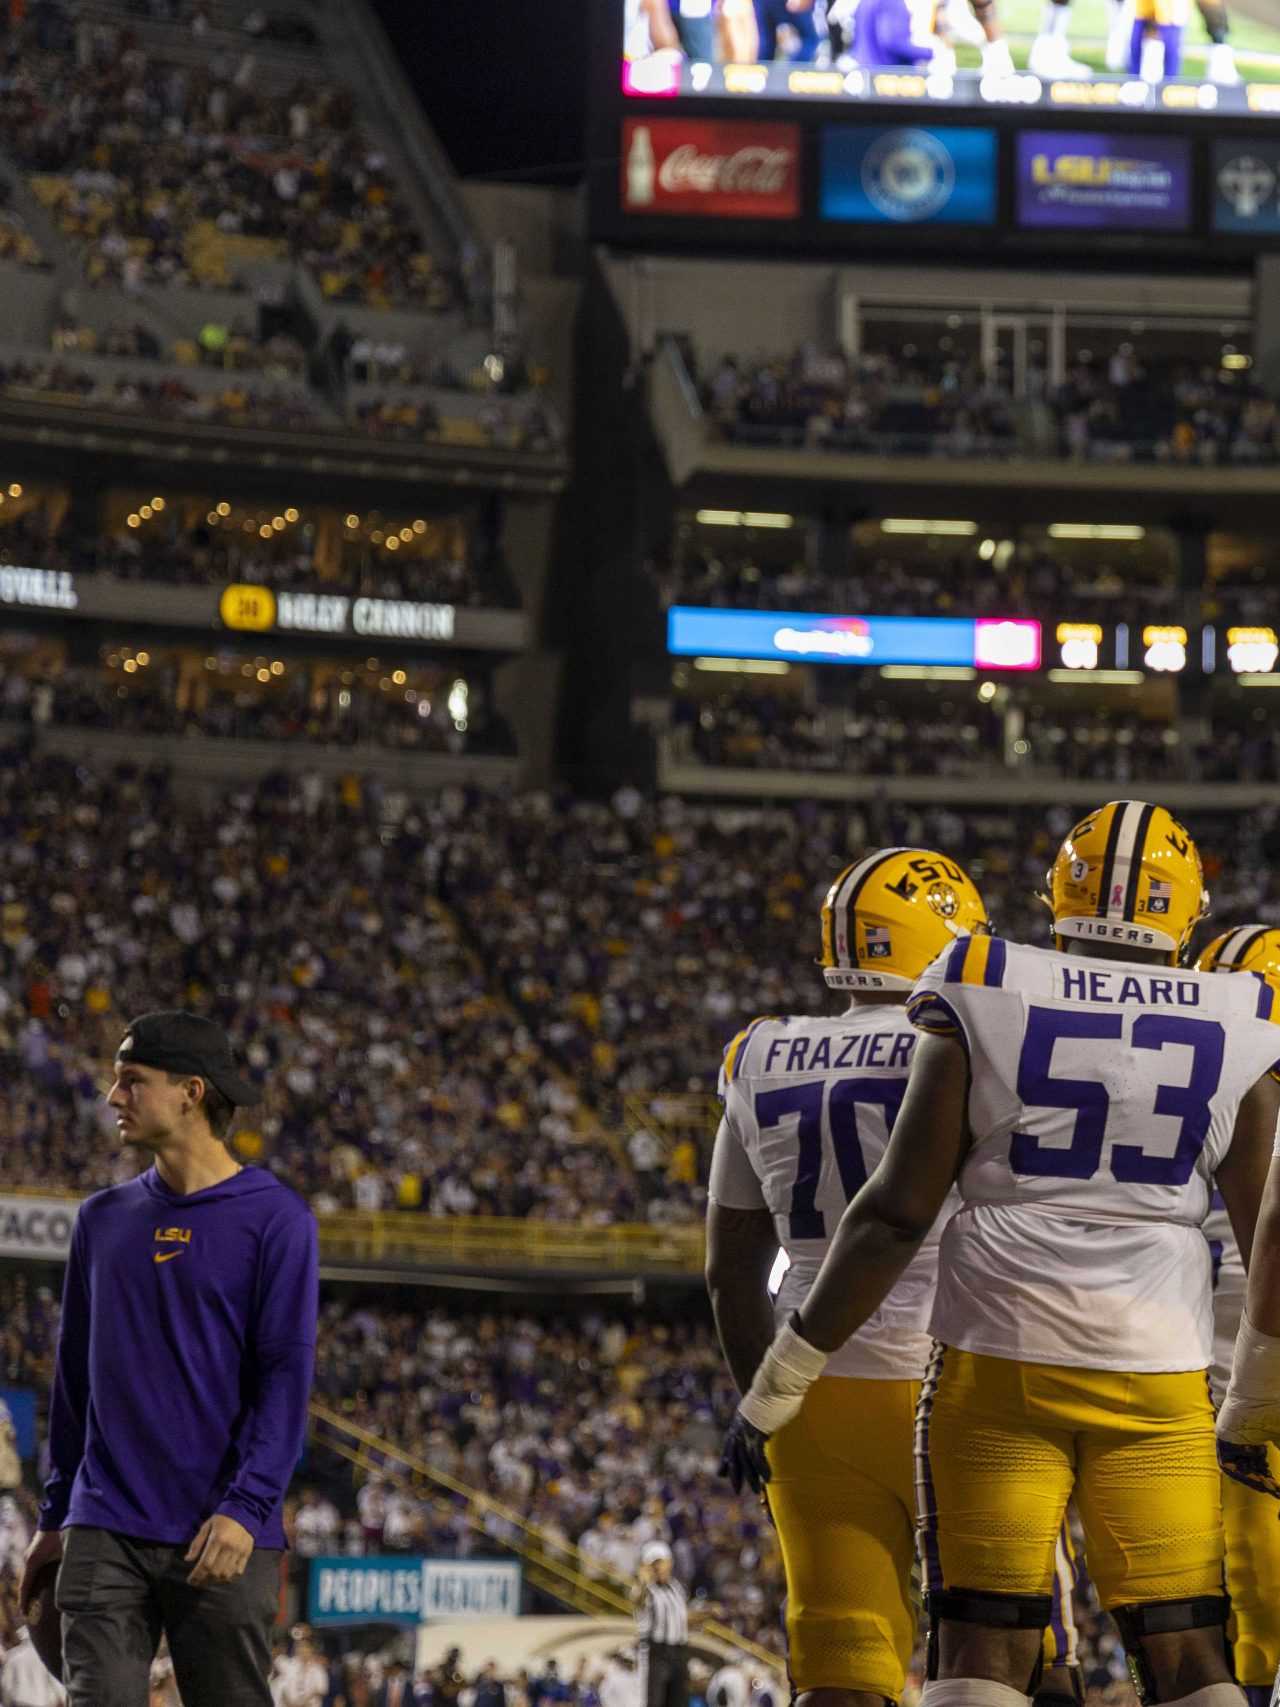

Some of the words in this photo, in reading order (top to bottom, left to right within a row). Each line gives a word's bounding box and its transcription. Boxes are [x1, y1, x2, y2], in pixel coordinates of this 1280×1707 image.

[353, 598, 455, 640] CANNON
[1075, 922, 1155, 944] TIGERS
[1062, 967, 1200, 1007] HEARD
[765, 1032, 915, 1073] FRAZIER
[1008, 1005, 1226, 1185] 53
[755, 1077, 908, 1240] 70
[0, 1207, 71, 1247] ACO
[155, 1227, 192, 1246] LSU
[318, 1568, 420, 1614] PEOPLES
